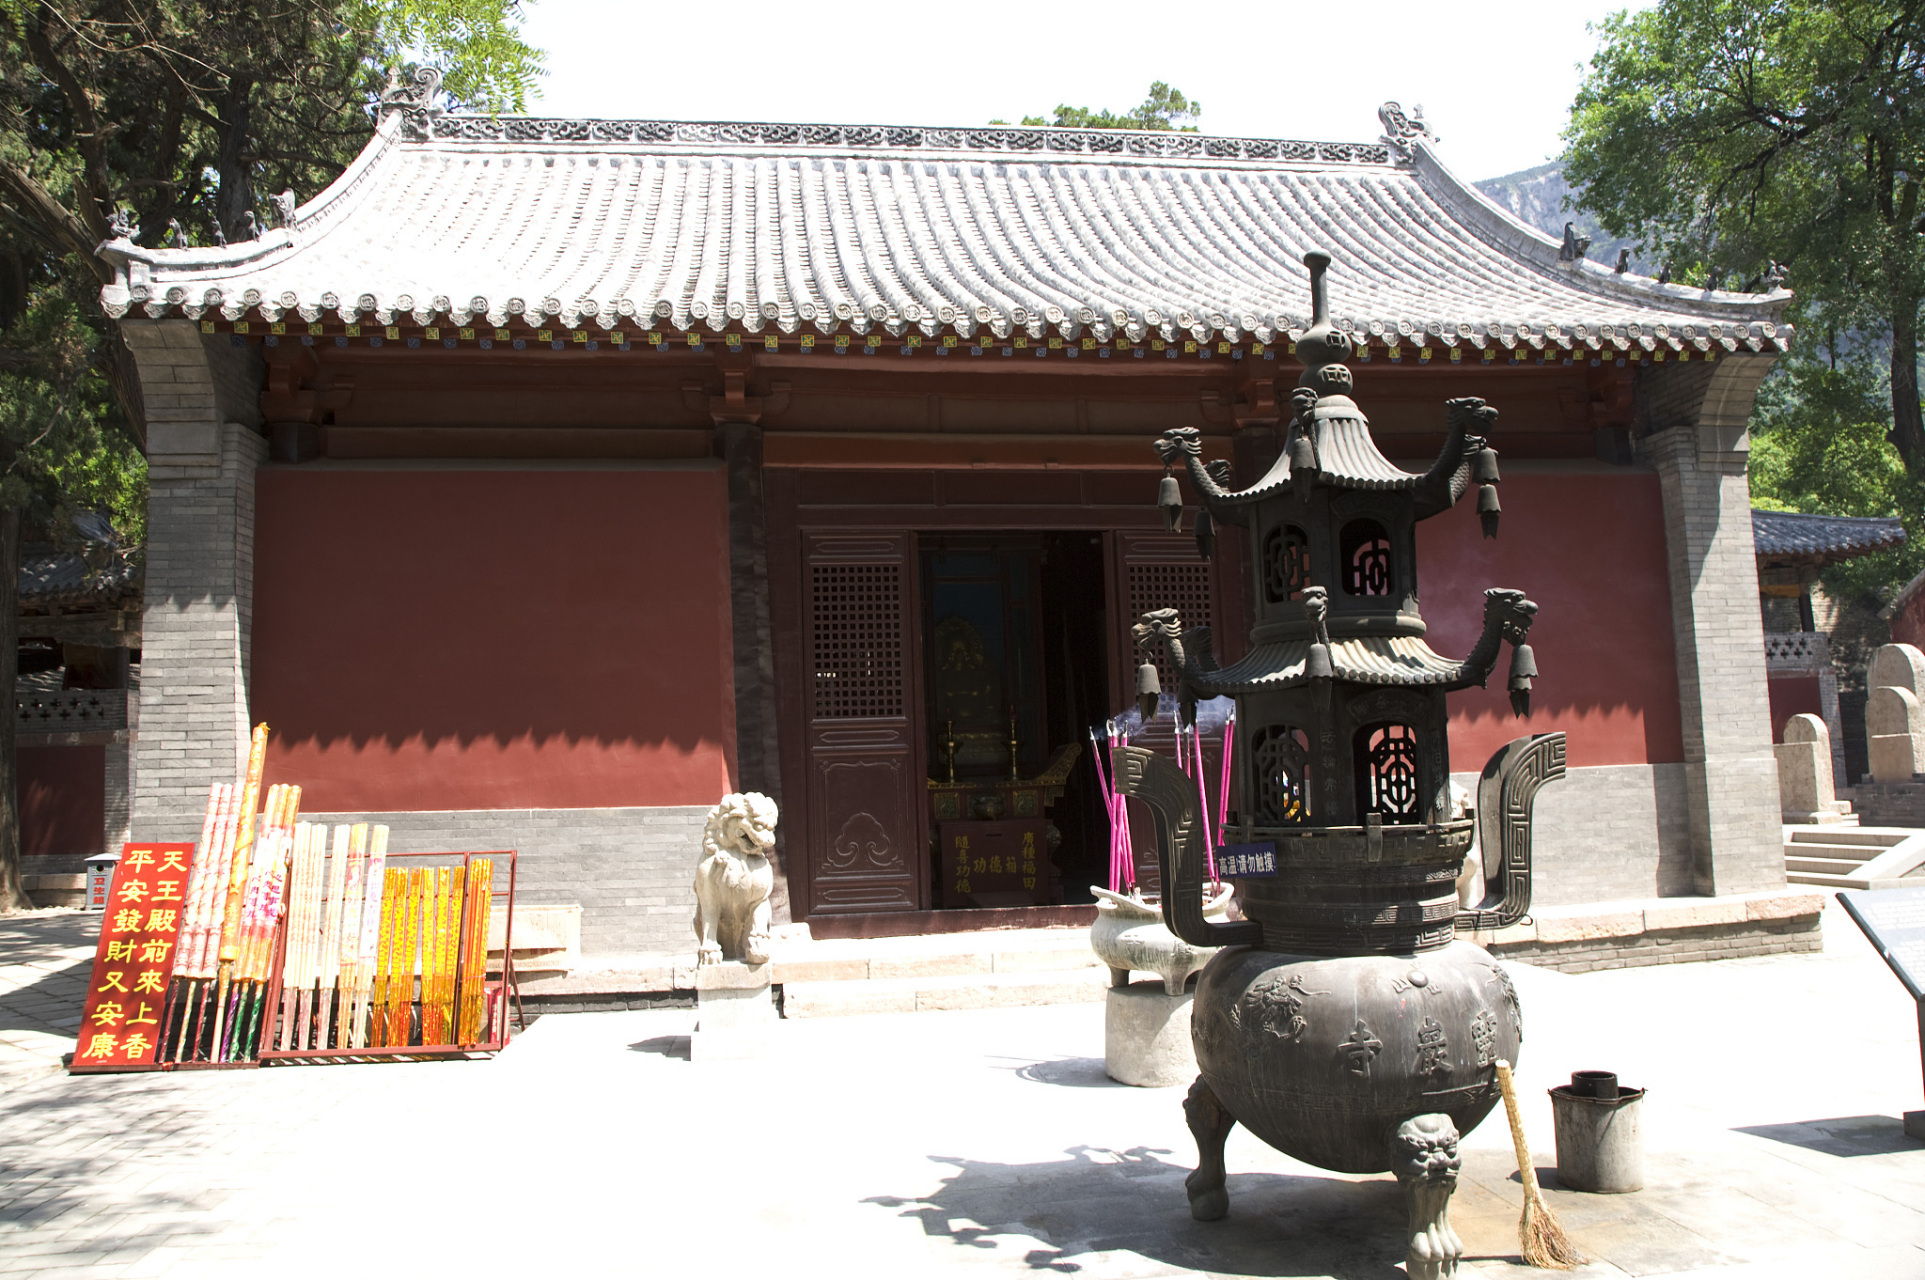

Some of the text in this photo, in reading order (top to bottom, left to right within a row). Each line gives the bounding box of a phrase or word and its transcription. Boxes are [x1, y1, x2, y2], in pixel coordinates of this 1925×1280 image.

[82, 849, 156, 1059] 平安發財又安康
[120, 850, 187, 1059] 天王殿前來上香
[973, 854, 1017, 875] 功德箱
